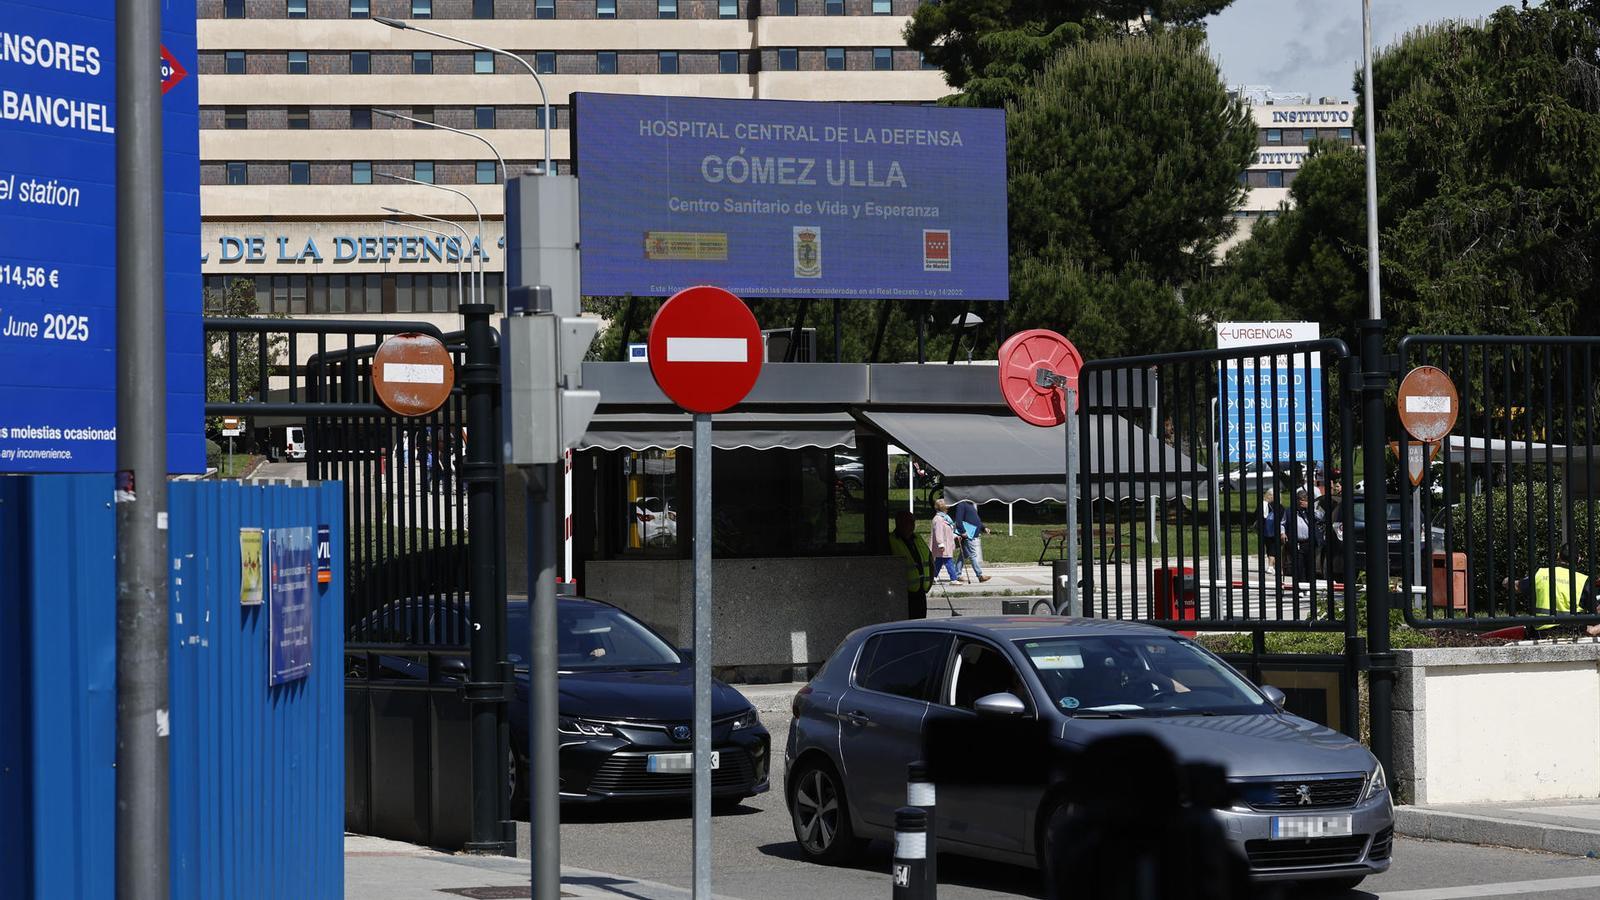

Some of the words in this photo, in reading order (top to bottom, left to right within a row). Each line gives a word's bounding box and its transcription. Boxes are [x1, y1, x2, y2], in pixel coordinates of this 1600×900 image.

[0, 32, 100, 76] NSORES
[0, 90, 115, 134] BANCHEL
[1272, 110, 1349, 123] INSTITUTO
[639, 120, 729, 139] HOSPITAL
[735, 123, 819, 142] CENTRAL
[824, 126, 848, 143] DE
[854, 127, 877, 144] LA
[881, 128, 963, 147] DEFENSA
[701, 146, 817, 185] GÓMEZ
[826, 159, 908, 188] ULLA
[19, 178, 80, 207] station
[668, 197, 720, 212] Centro
[724, 198, 790, 214] Sanitario
[794, 200, 812, 215] de
[816, 200, 848, 216] Vida
[852, 203, 861, 219] y
[865, 202, 940, 219] Esperanza
[219, 235, 267, 264] DE
[276, 235, 324, 264] LA
[333, 234, 490, 264] DEFENSA
[0, 264, 45, 290] 14,56
[49, 269, 59, 288] €
[3, 315, 38, 338] June
[43, 313, 89, 341] 2025
[1231, 328, 1293, 340] URGENCIAS
[11, 425, 61, 439] molestias
[64, 426, 117, 440] ocasionad
[1, 449, 16, 461] any
[16, 448, 73, 459] inconvenience.
[896, 865, 908, 886] 54
